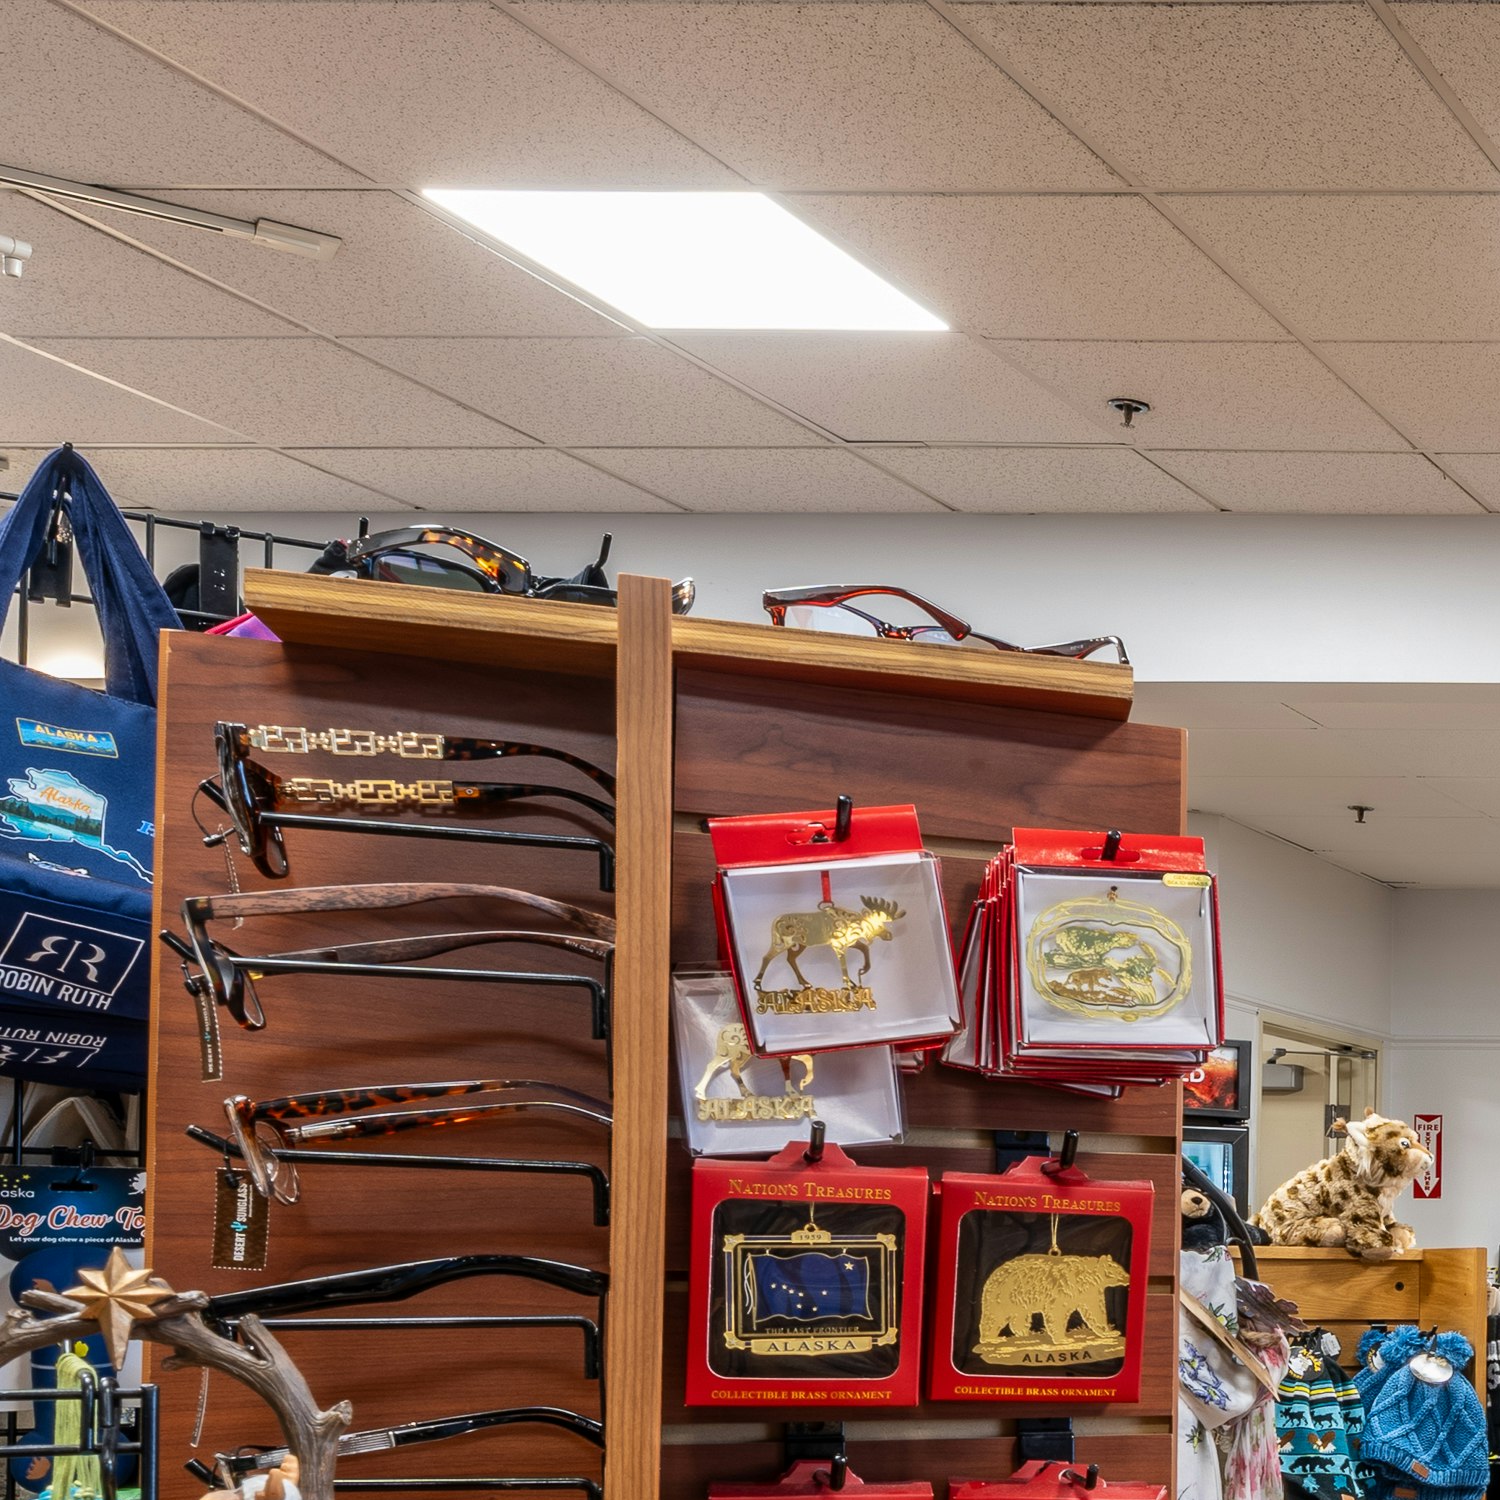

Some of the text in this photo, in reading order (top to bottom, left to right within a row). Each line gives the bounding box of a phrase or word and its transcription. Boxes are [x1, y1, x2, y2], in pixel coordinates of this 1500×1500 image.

[35, 724, 98, 743] ALASKA
[40, 786, 91, 814] Alaska
[57, 984, 112, 1010] RUTH
[756, 987, 876, 1014] ALASKA
[46, 1032, 107, 1048] ROBIN
[804, 1182, 892, 1200] TREASURES
[1042, 1194, 1120, 1212] TREASURES
[0, 1204, 46, 1236] Dog
[48, 1205, 114, 1230] Chew
[23, 1237, 40, 1245] your
[42, 1236, 57, 1245] dog
[58, 1236, 76, 1244] chew
[85, 1236, 104, 1245] piece
[813, 1326, 860, 1334] FRONTIER
[767, 1340, 857, 1352] ALASKA
[1022, 1350, 1092, 1364] ALASKA
[711, 1390, 892, 1400] COLLECTIBLE BRASS ORNAMENT
